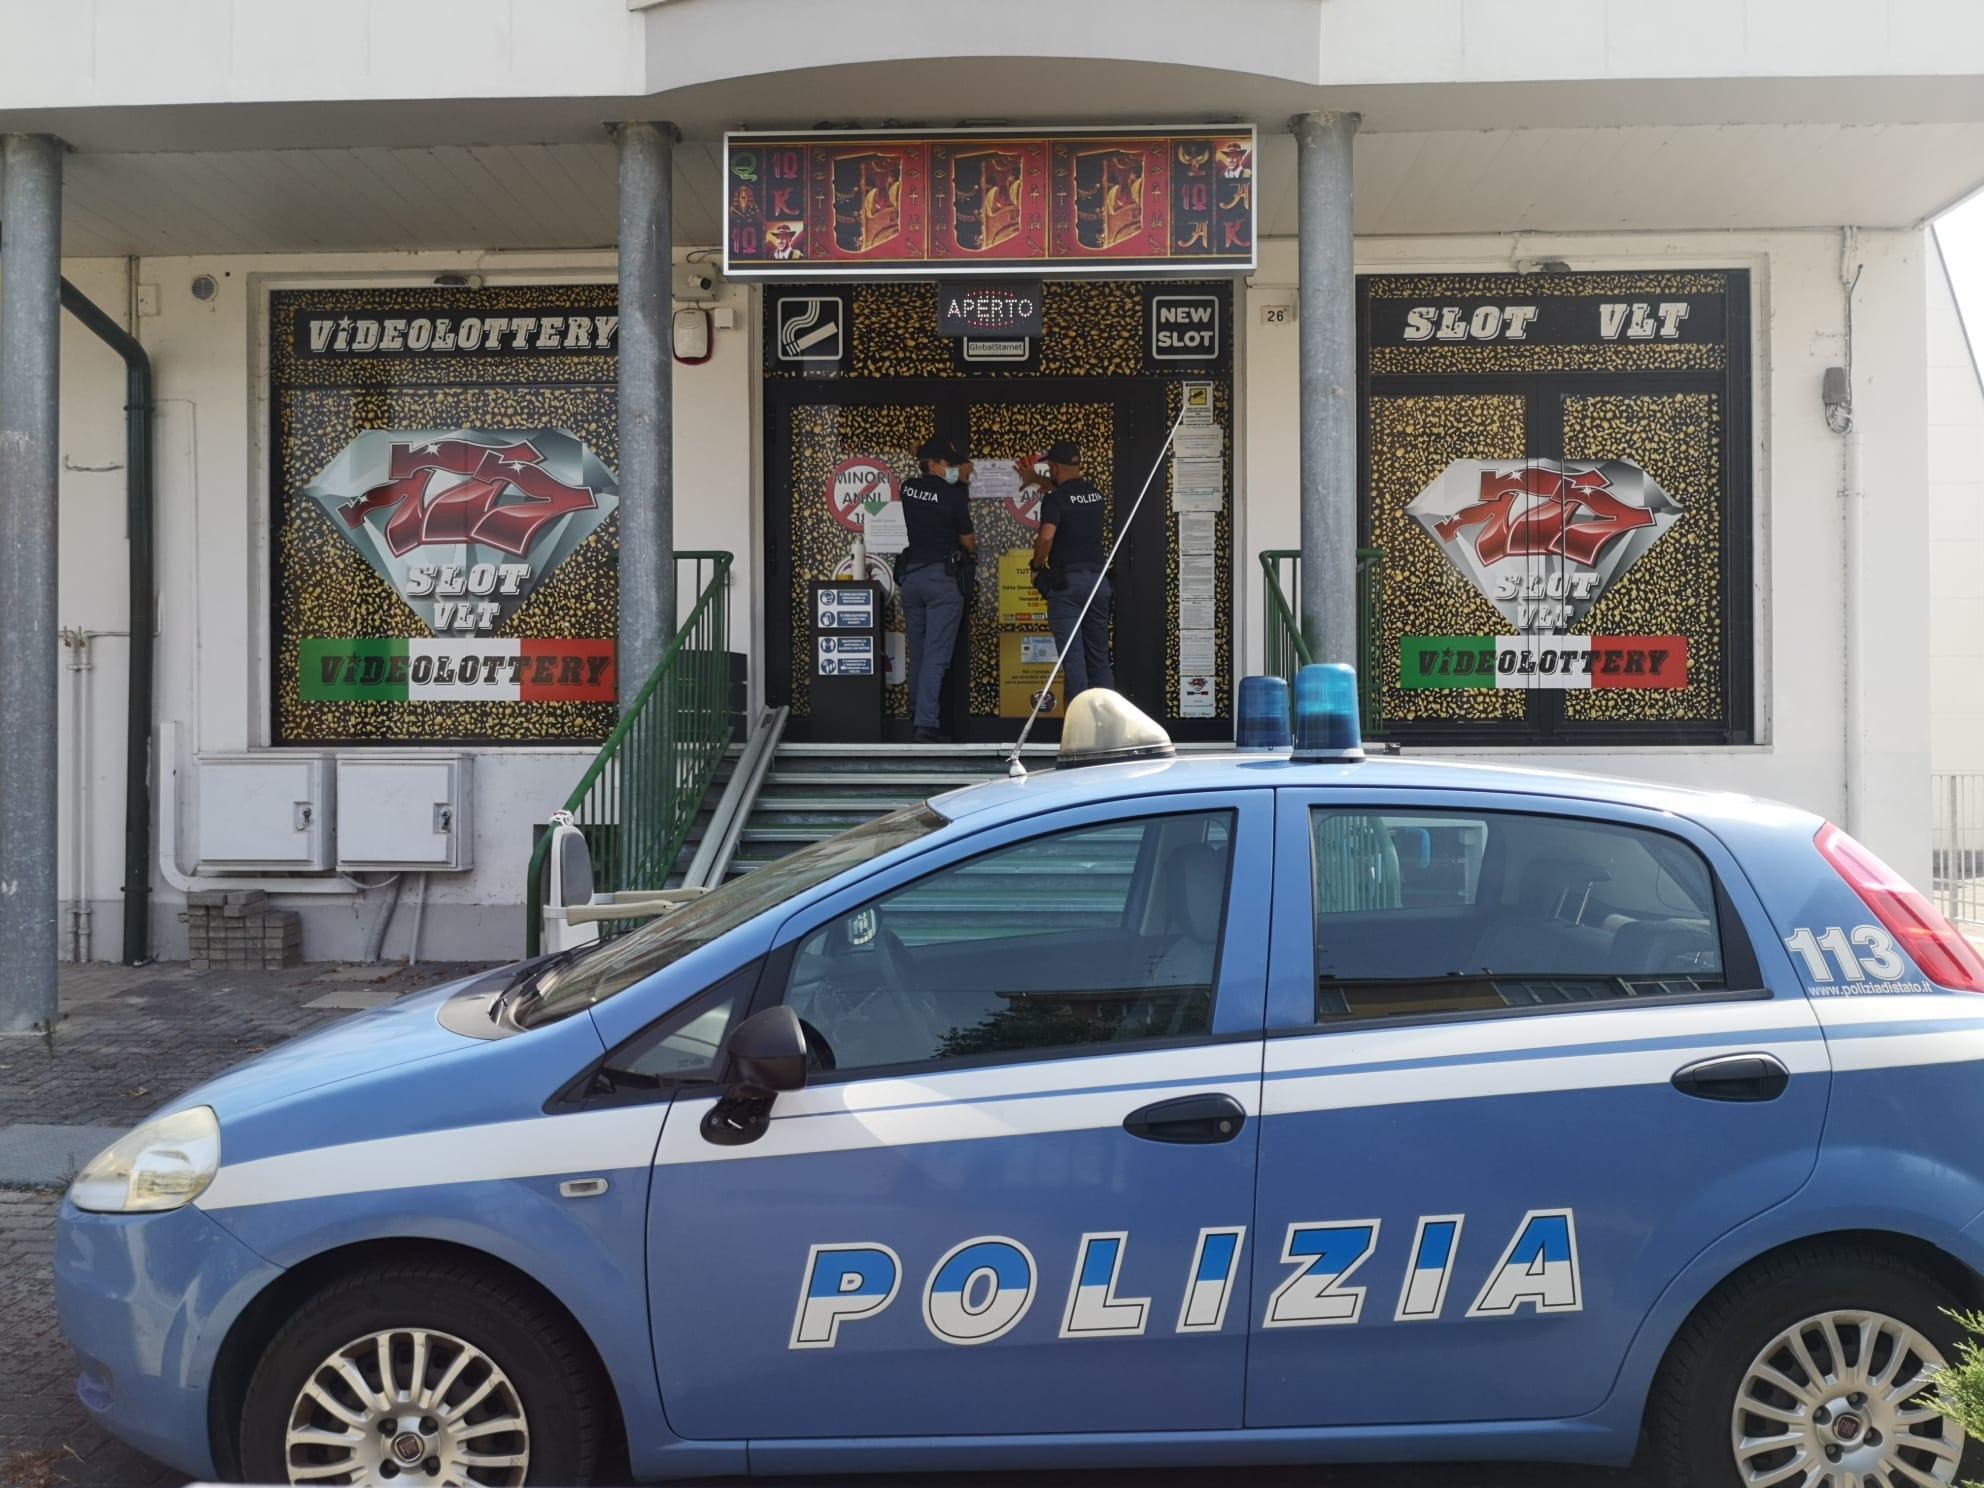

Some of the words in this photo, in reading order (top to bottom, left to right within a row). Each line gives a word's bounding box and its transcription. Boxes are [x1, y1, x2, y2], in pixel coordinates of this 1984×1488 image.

[946, 298, 1033, 318] APERTO
[1160, 307, 1212, 324] NEW
[1267, 310, 1284, 322] 26
[1403, 305, 1538, 341] SLOT
[1599, 302, 1690, 339] VLT
[1157, 331, 1214, 347] SLOT
[834, 471, 890, 485] MINORI
[903, 486, 938, 503] POLIZIA
[406, 563, 532, 596] SLOT
[1495, 572, 1600, 600] SLOT
[434, 602, 499, 630] VLT
[1516, 605, 1573, 629] VLT
[1785, 924, 1905, 982] 113
[1809, 981, 1933, 997] www.poliziadistato.it
[788, 1207, 1584, 1350] POLIZIA
